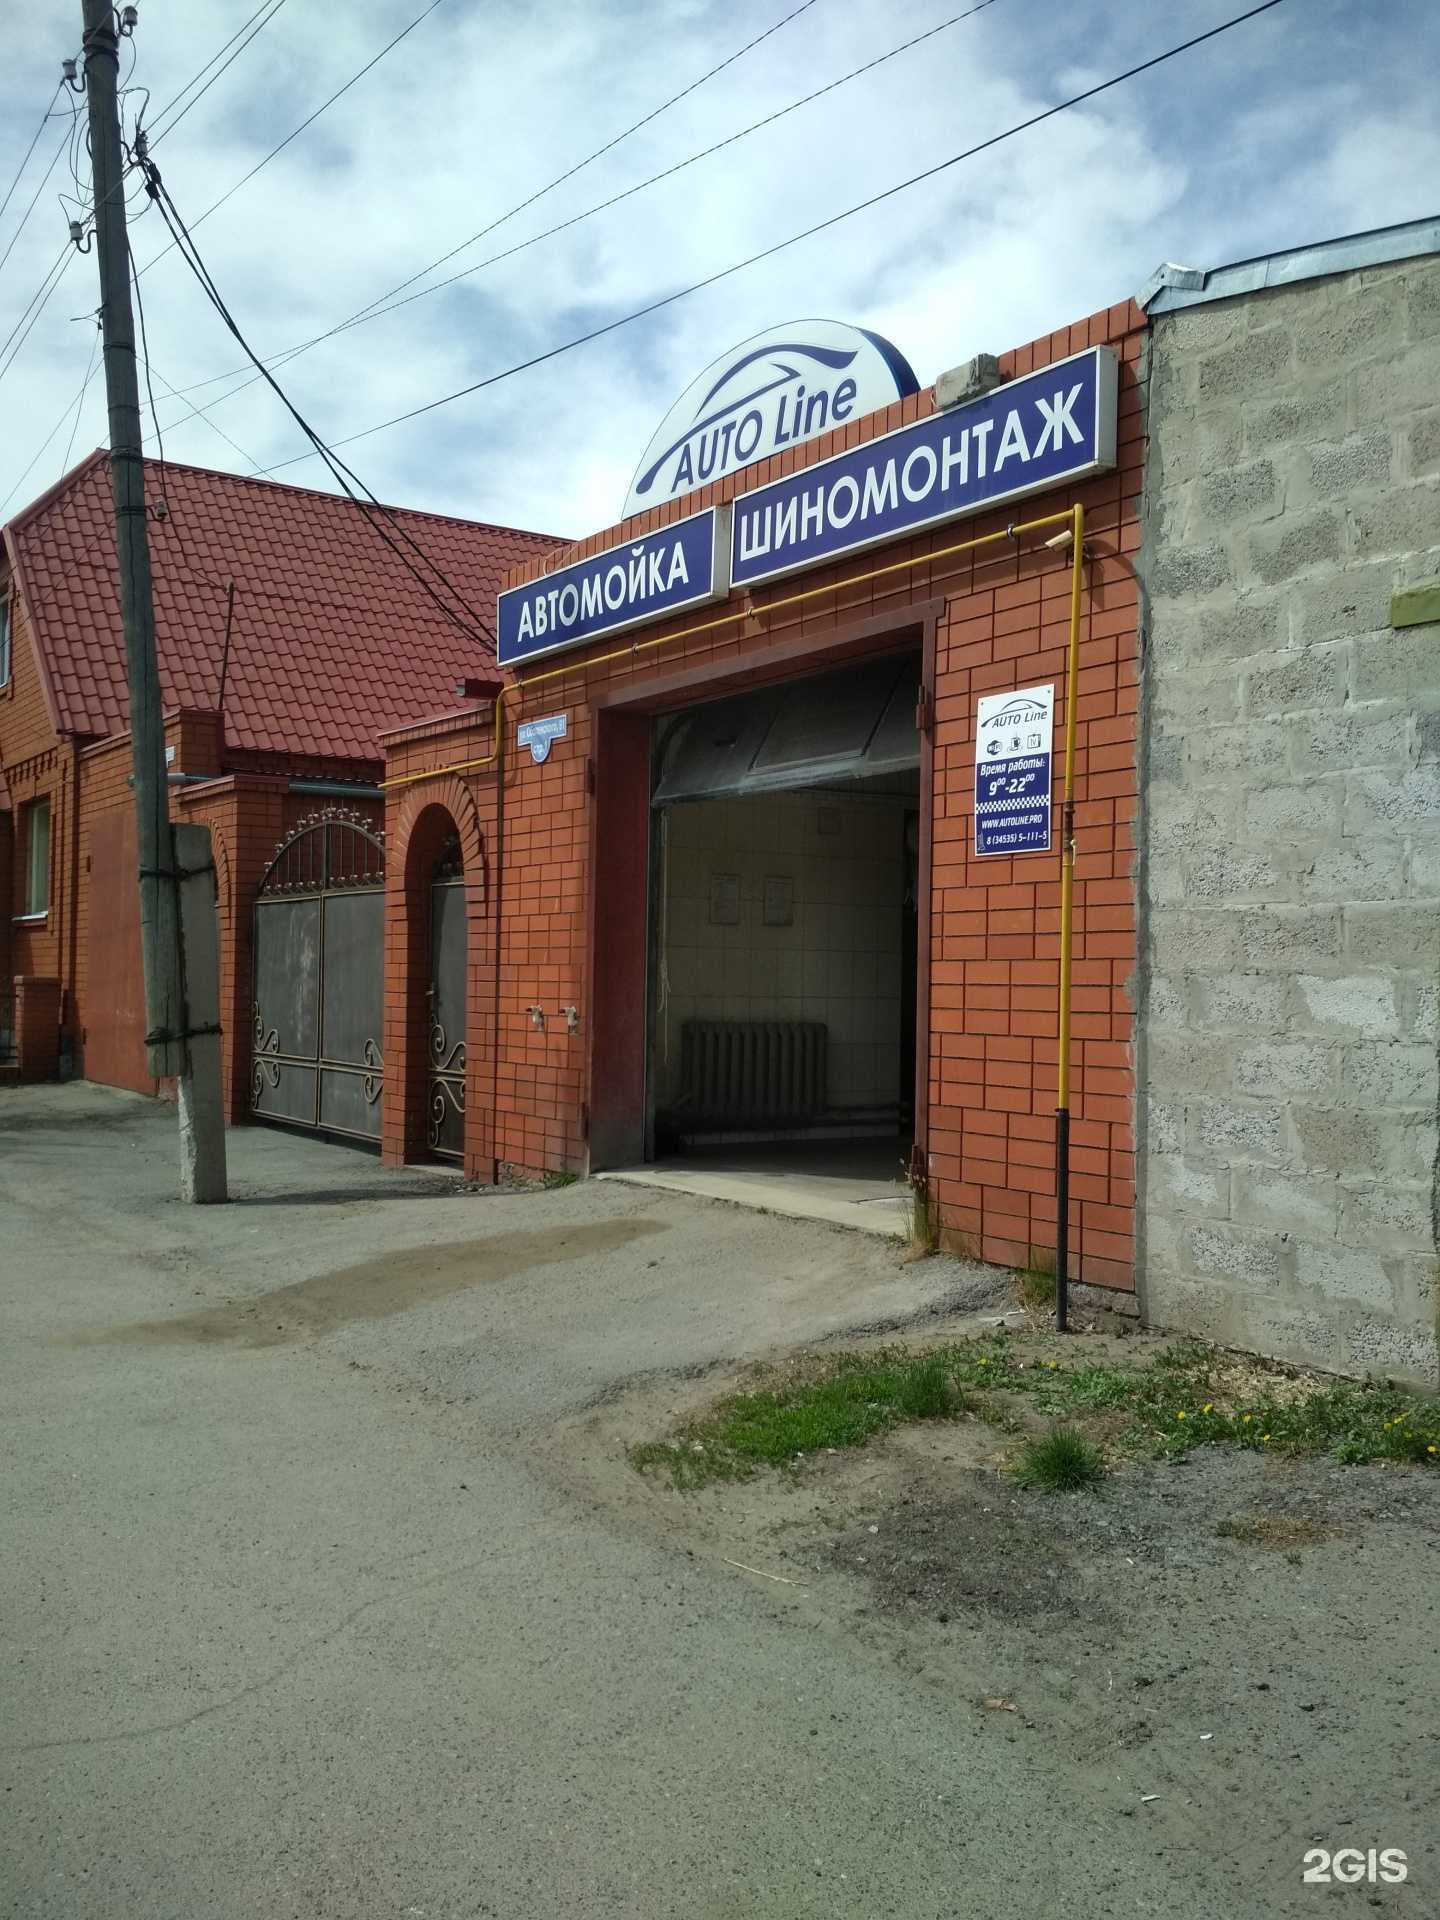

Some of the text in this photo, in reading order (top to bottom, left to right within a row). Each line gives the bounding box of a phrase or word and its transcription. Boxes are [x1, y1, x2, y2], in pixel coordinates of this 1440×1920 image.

[671, 377, 858, 493] AUTO Line
[739, 382, 1084, 562] ШИНОМОНТАЖ
[517, 542, 689, 643] АВТОМОЙКА
[992, 711, 1048, 728] AUTO Line
[980, 758, 1046, 776] Время работы:
[981, 814, 1043, 829] WWW.AUTOLINE.PRO
[986, 831, 1048, 845] 8 (34535) 5-111-5
